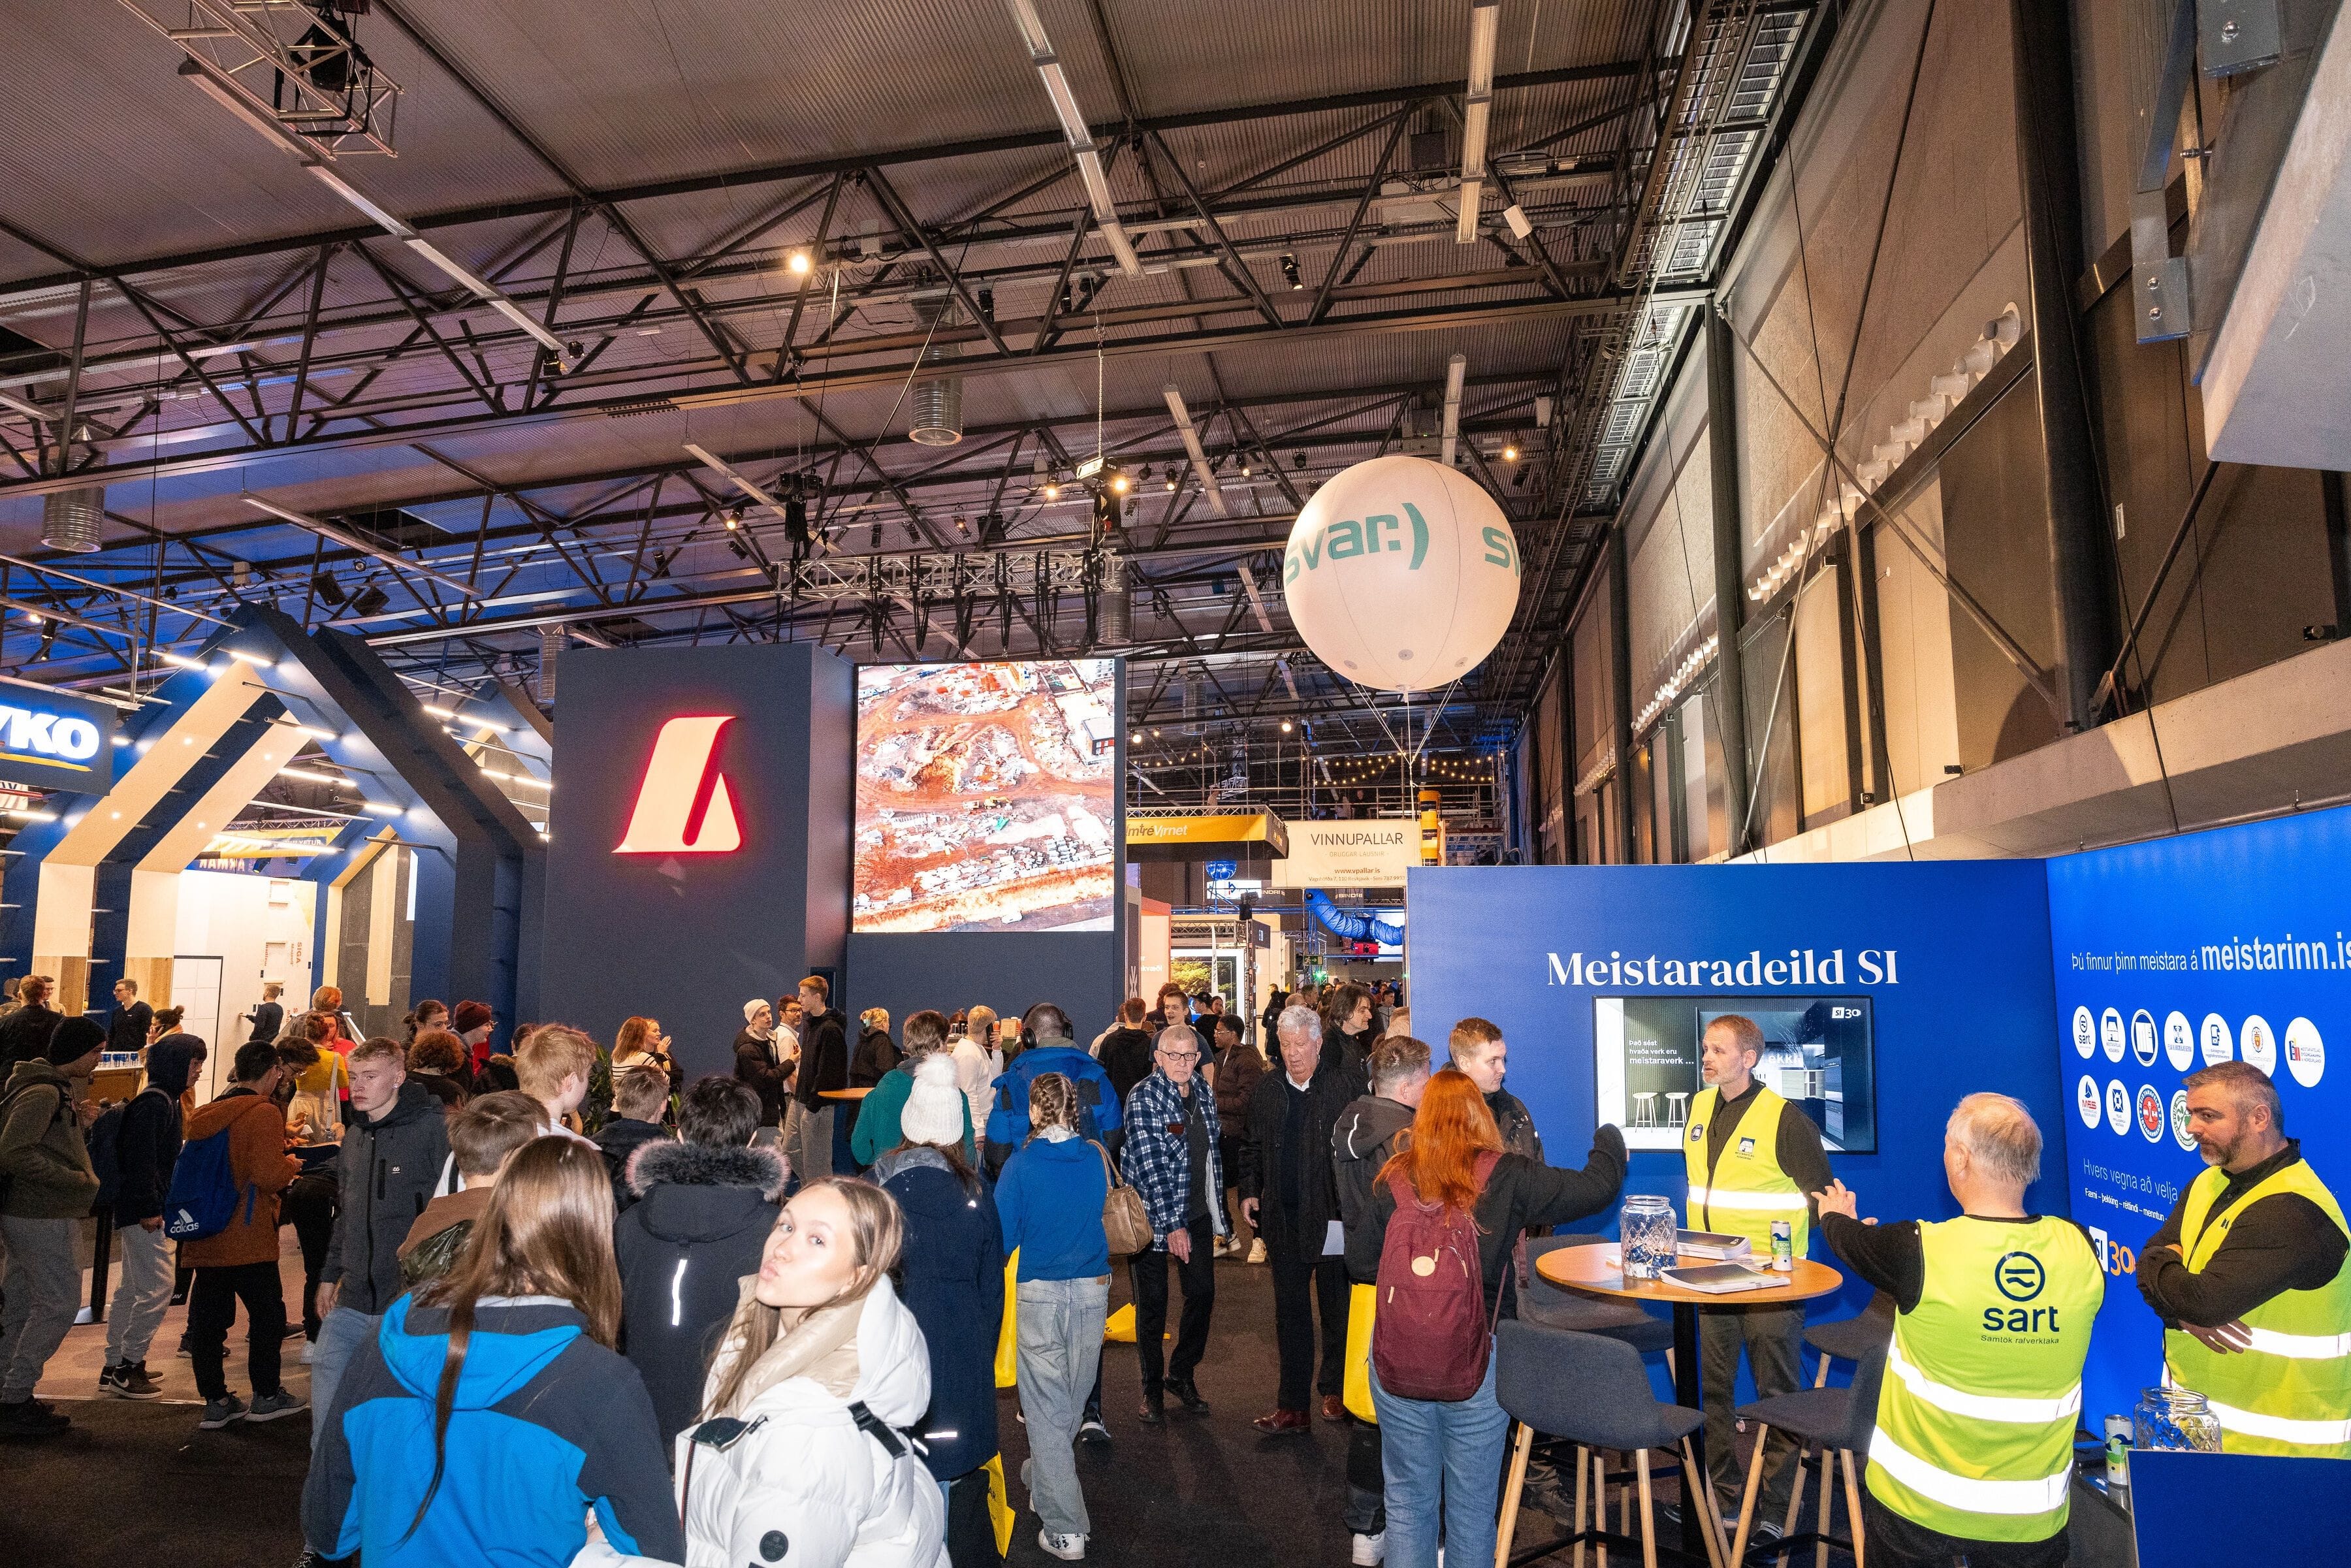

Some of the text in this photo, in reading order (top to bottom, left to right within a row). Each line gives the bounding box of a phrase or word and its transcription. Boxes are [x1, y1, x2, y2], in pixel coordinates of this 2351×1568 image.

[1310, 832, 1403, 846] VINNUPALLAR
[1546, 948, 1900, 987] Meistaradeild SI
[2071, 952, 2085, 970] Þú
[2086, 952, 2113, 970] finnur
[2115, 951, 2137, 974] þinn
[2139, 950, 2188, 970] meistara
[2190, 950, 2199, 970] á
[2078, 1034, 2091, 1045] sart
[2083, 1158, 2178, 1204] Hvers vegna að velja
[2143, 1208, 2165, 1222] menntun
[170, 1222, 199, 1234] adidas
[1982, 1305, 2060, 1333] sart
[1980, 1334, 2059, 1344] Samtök rafverktaka
